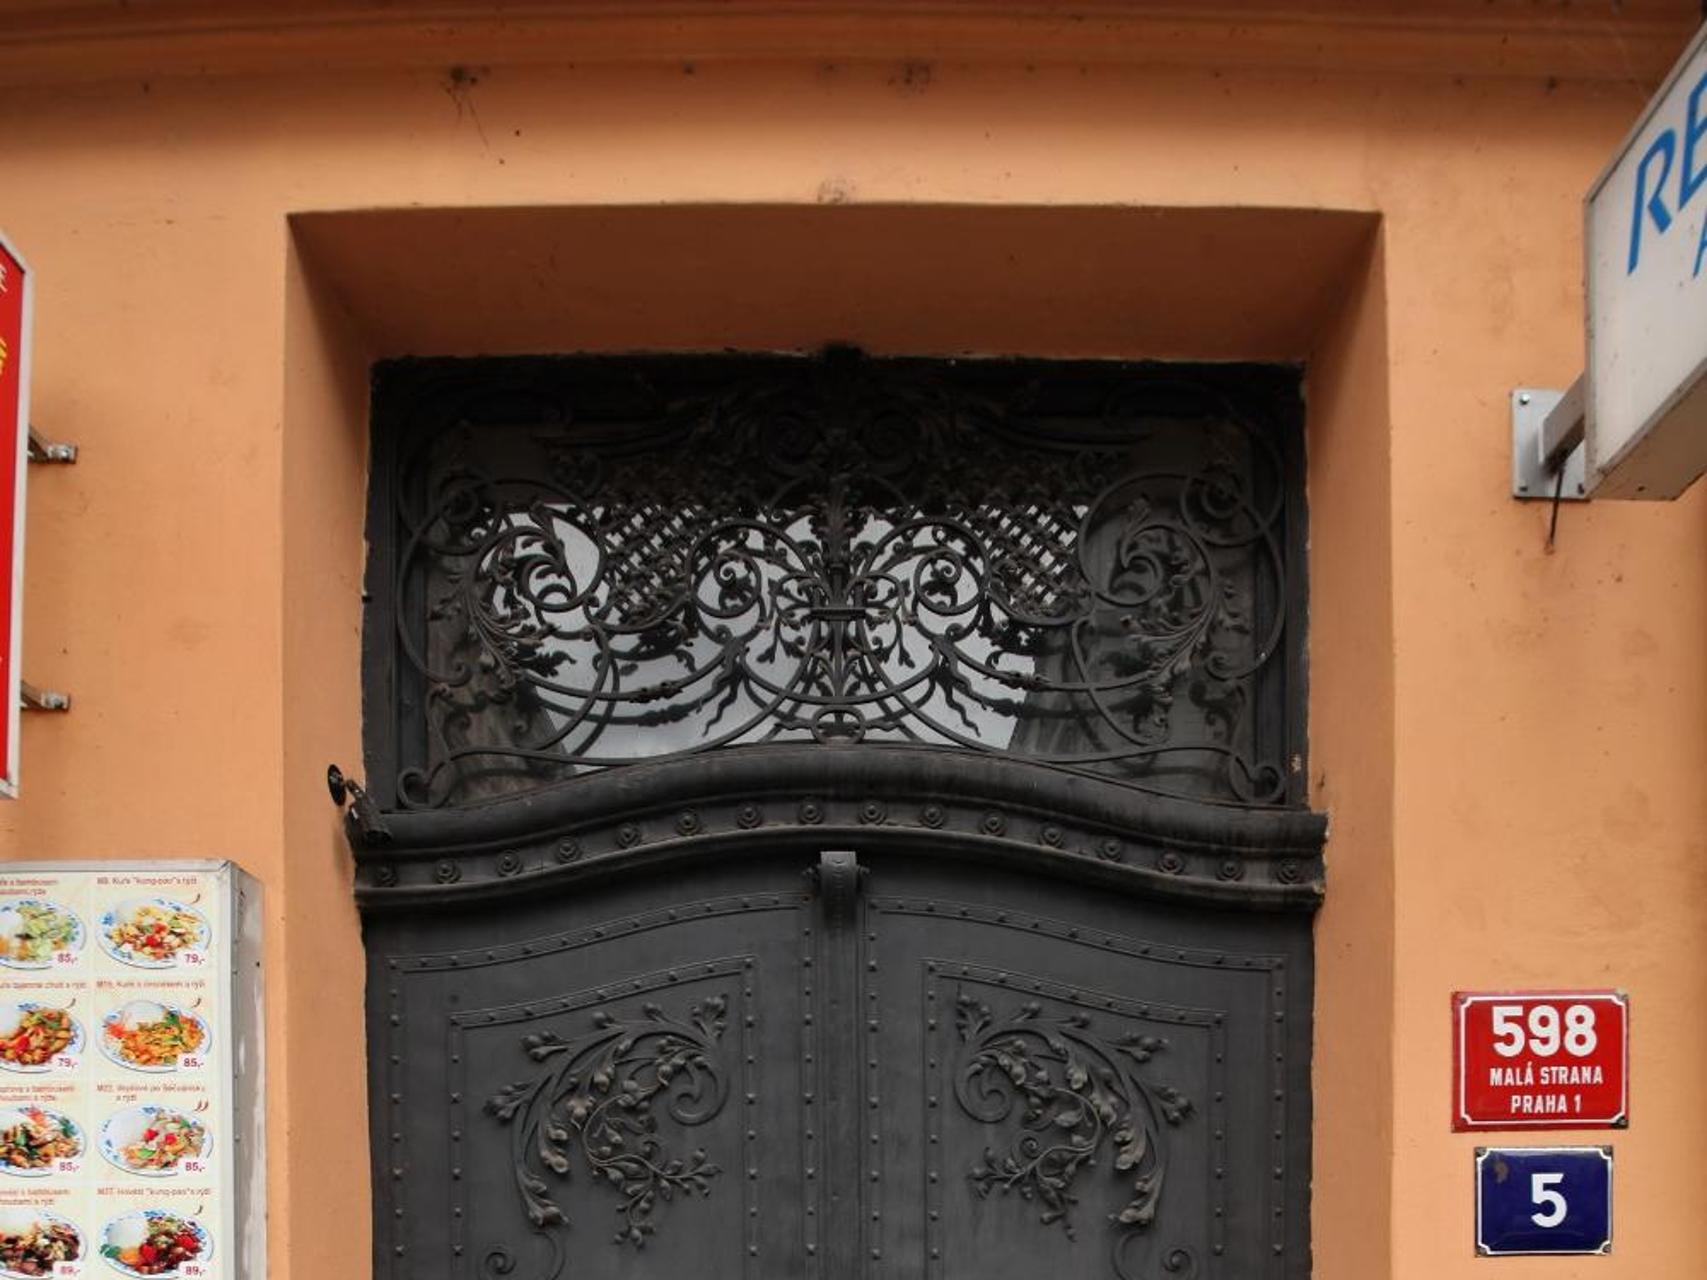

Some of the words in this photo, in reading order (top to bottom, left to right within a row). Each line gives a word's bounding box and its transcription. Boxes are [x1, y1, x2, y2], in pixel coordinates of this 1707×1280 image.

[1491, 1005, 1598, 1057] 598
[183, 1058, 205, 1068] 85,-
[1489, 1062, 1534, 1087] MALÁ
[1539, 1066, 1604, 1086] STRANA
[1510, 1094, 1568, 1114] PRAHA
[1574, 1094, 1582, 1113] 1
[1530, 1173, 1568, 1228] 5
